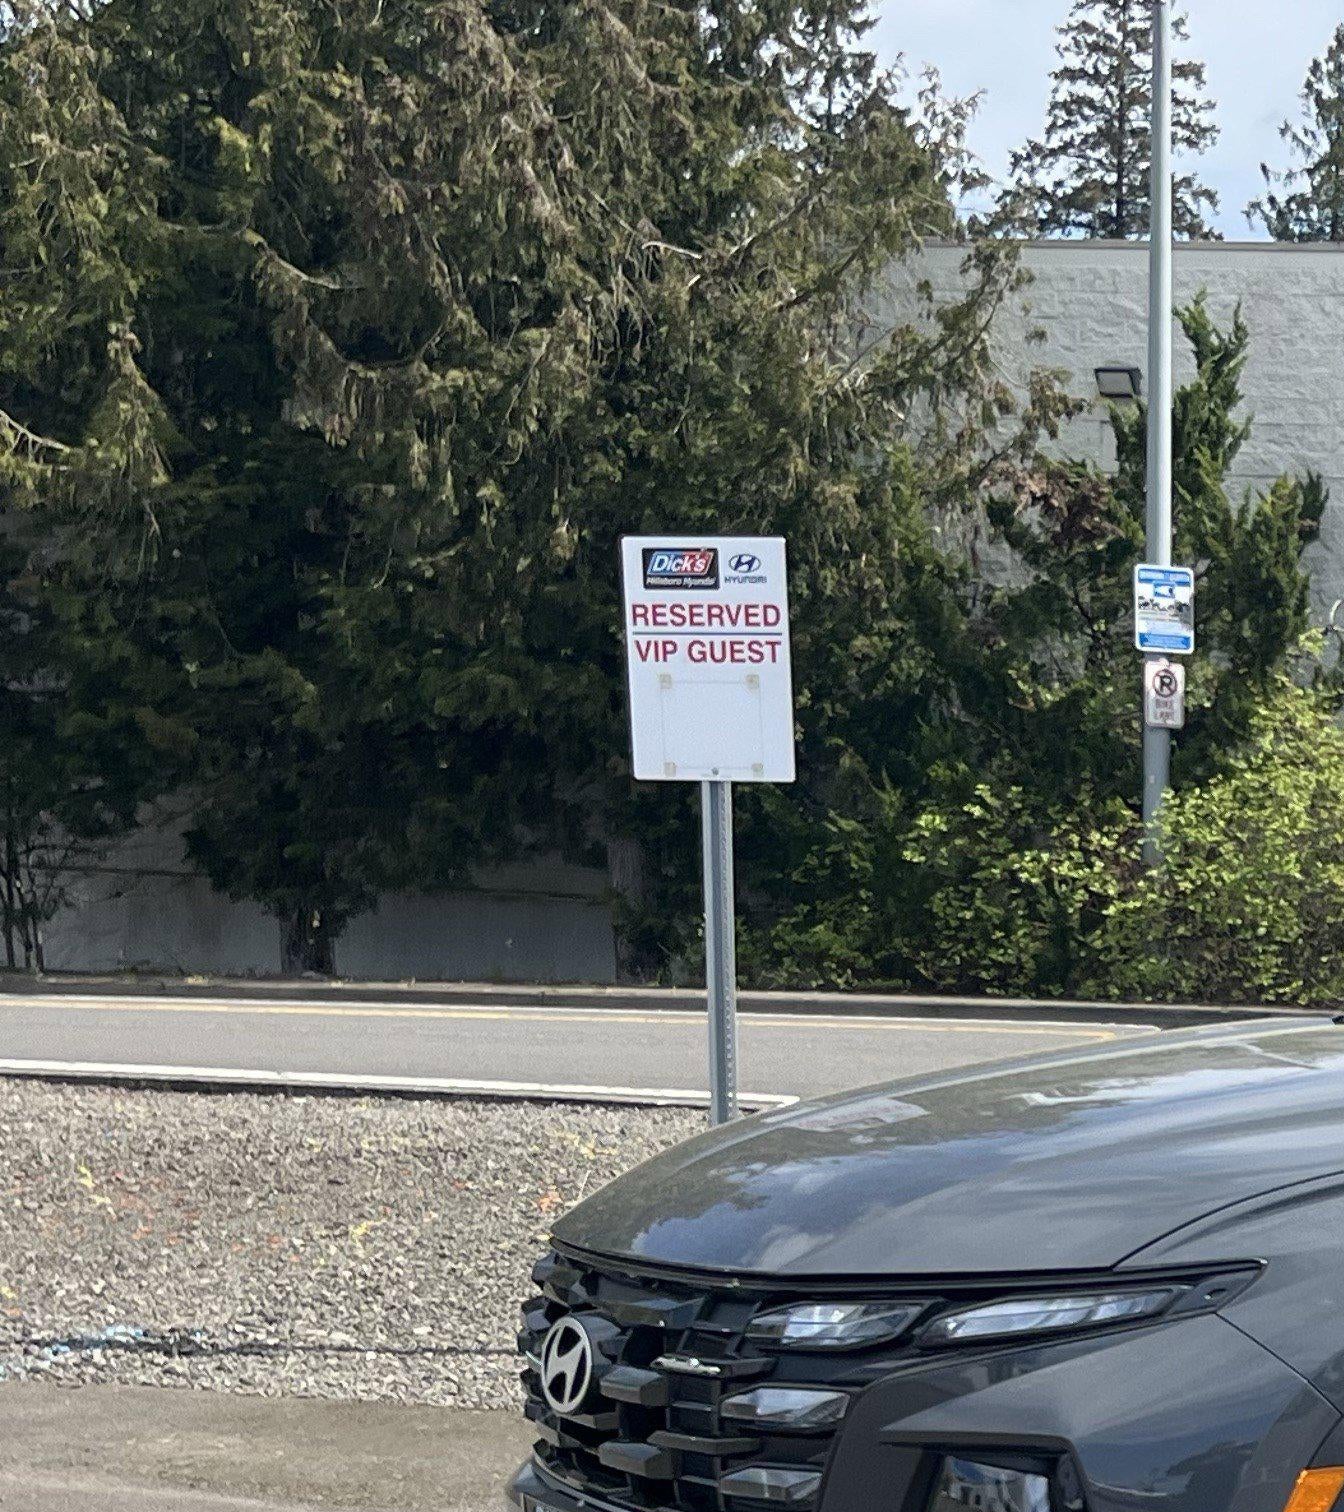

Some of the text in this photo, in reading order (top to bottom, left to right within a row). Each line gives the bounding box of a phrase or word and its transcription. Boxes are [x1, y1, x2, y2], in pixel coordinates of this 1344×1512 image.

[631, 603, 781, 628] RESERVED
[633, 639, 782, 664] VIP GUEST
